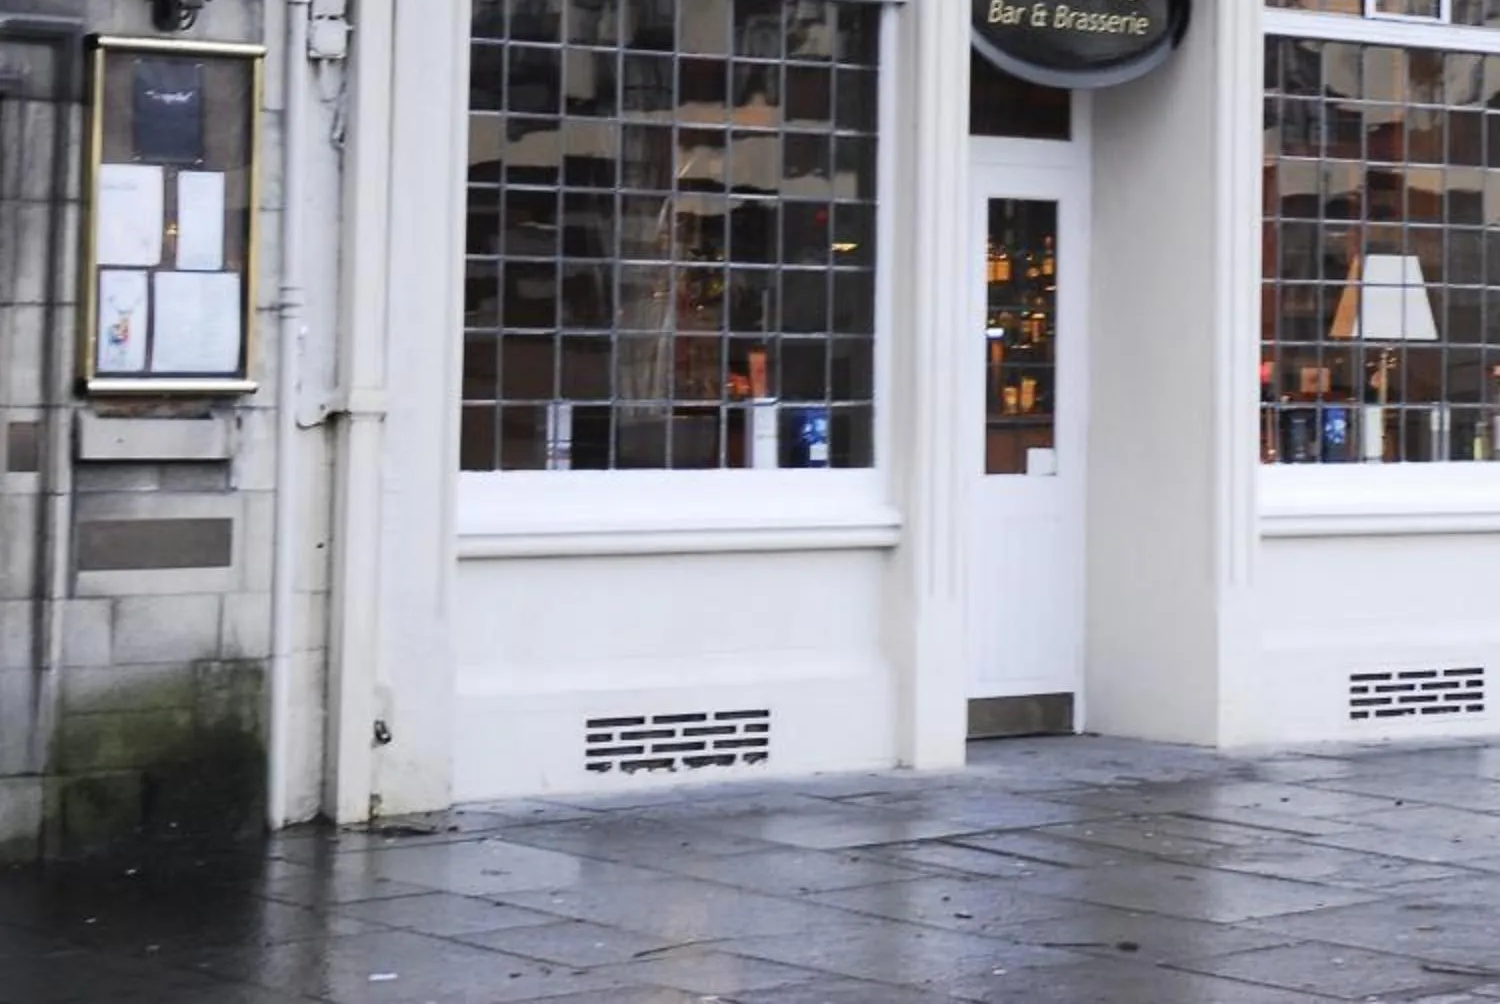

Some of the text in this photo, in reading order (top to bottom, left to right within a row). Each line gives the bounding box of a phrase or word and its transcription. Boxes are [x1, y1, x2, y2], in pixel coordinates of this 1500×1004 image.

[987, 0, 1150, 35] Bar & Brasserie
